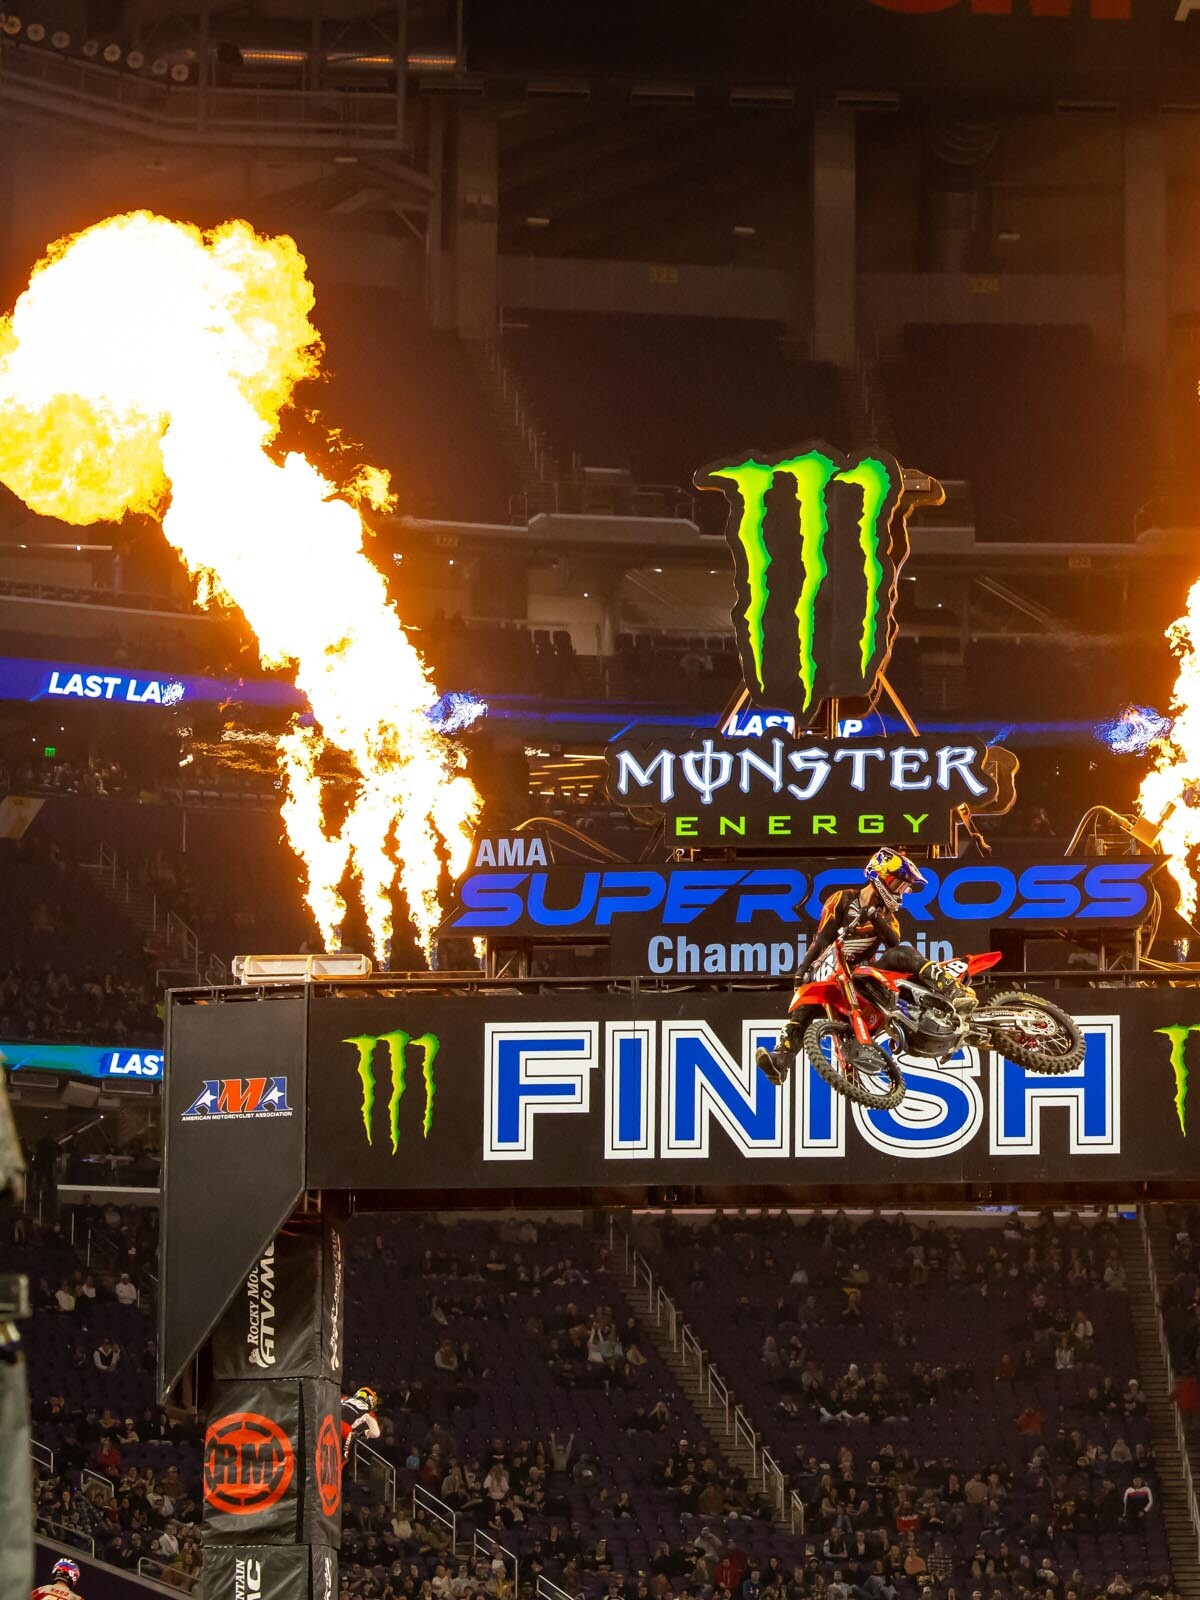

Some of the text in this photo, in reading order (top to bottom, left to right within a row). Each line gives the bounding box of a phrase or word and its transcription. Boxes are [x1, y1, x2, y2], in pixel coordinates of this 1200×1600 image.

[48, 671, 121, 699] LAST
[616, 737, 990, 804] MONSTER
[675, 813, 929, 837] ENERGY
[475, 838, 548, 867] AMA
[647, 932, 953, 975] Champiip
[109, 1053, 164, 1075] LAS
[181, 1076, 293, 1116] AMA
[483, 1015, 1121, 1160] FINISH
[214, 1442, 273, 1485] RM
